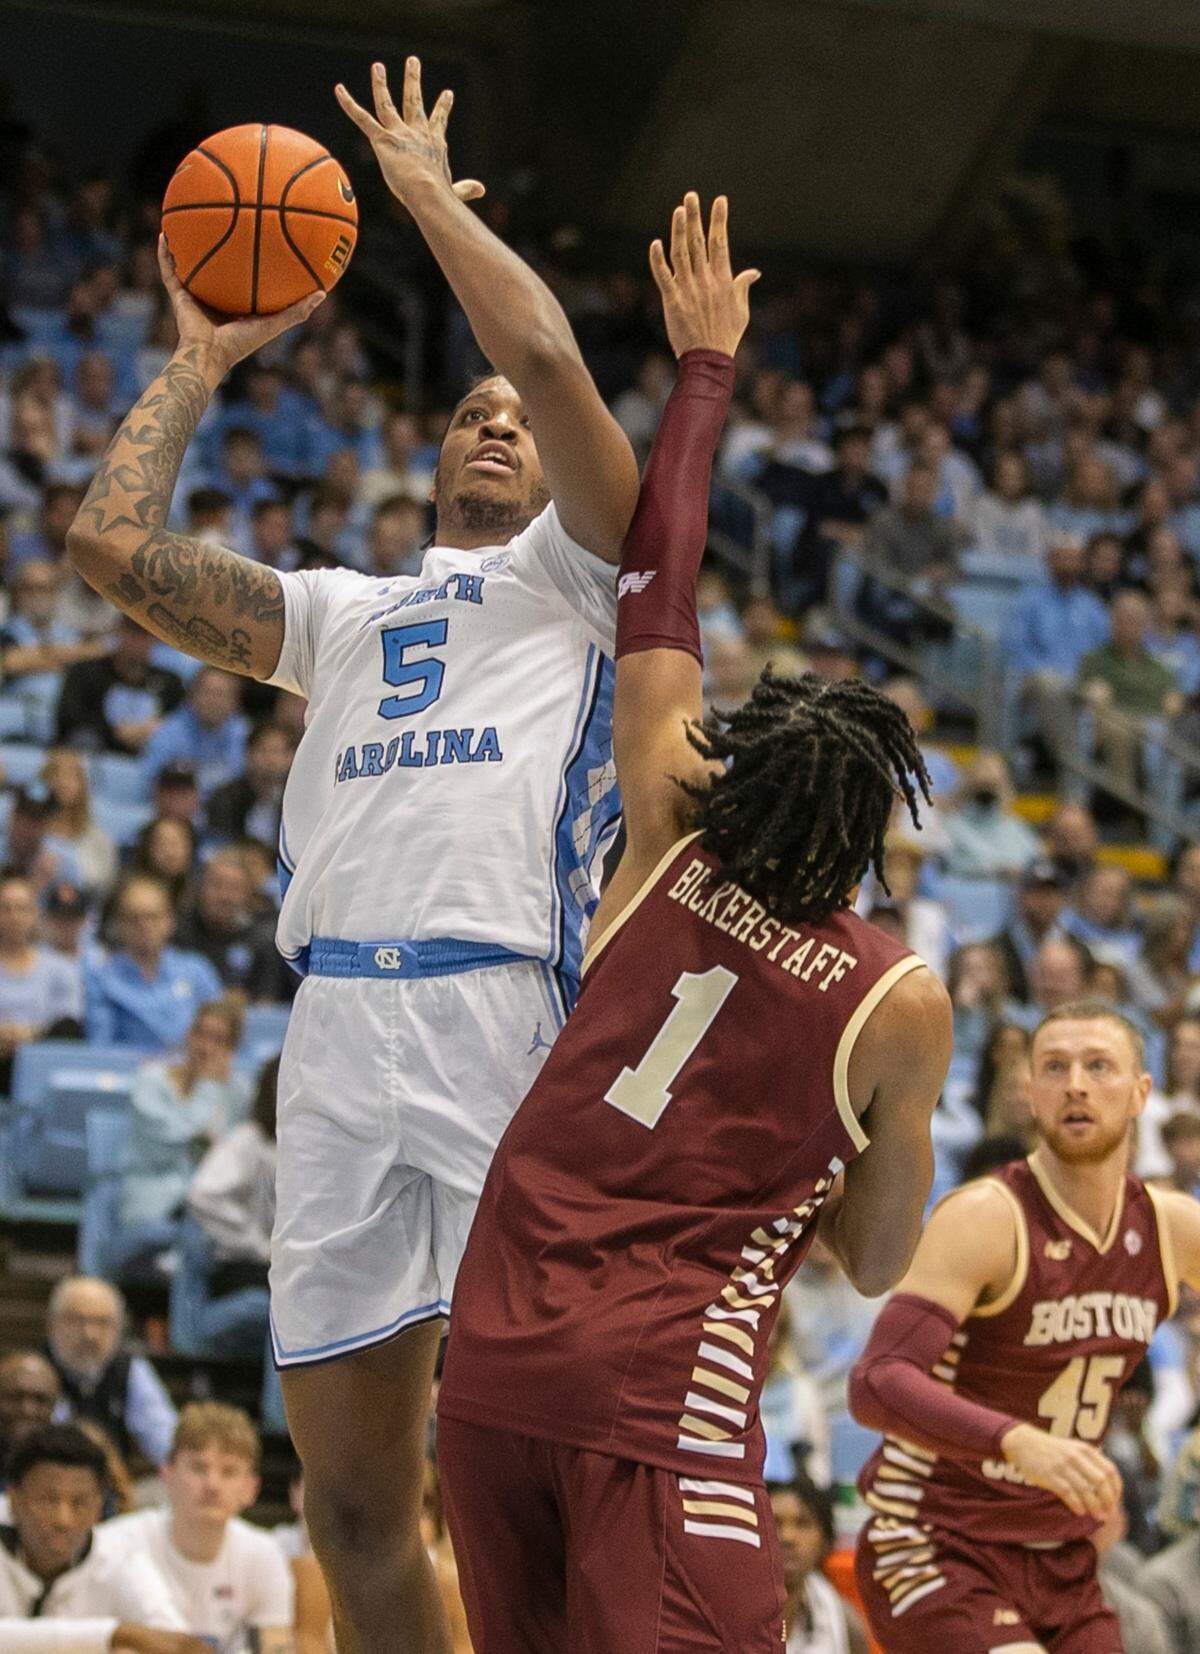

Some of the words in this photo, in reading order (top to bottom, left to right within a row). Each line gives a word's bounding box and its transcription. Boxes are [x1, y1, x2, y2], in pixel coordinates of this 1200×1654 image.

[377, 618, 448, 720] 5
[334, 727, 502, 788] AROLINA
[603, 964, 739, 1130] 1
[1023, 1292, 1158, 1346] BOSTON
[1037, 1355, 1126, 1440] 45
